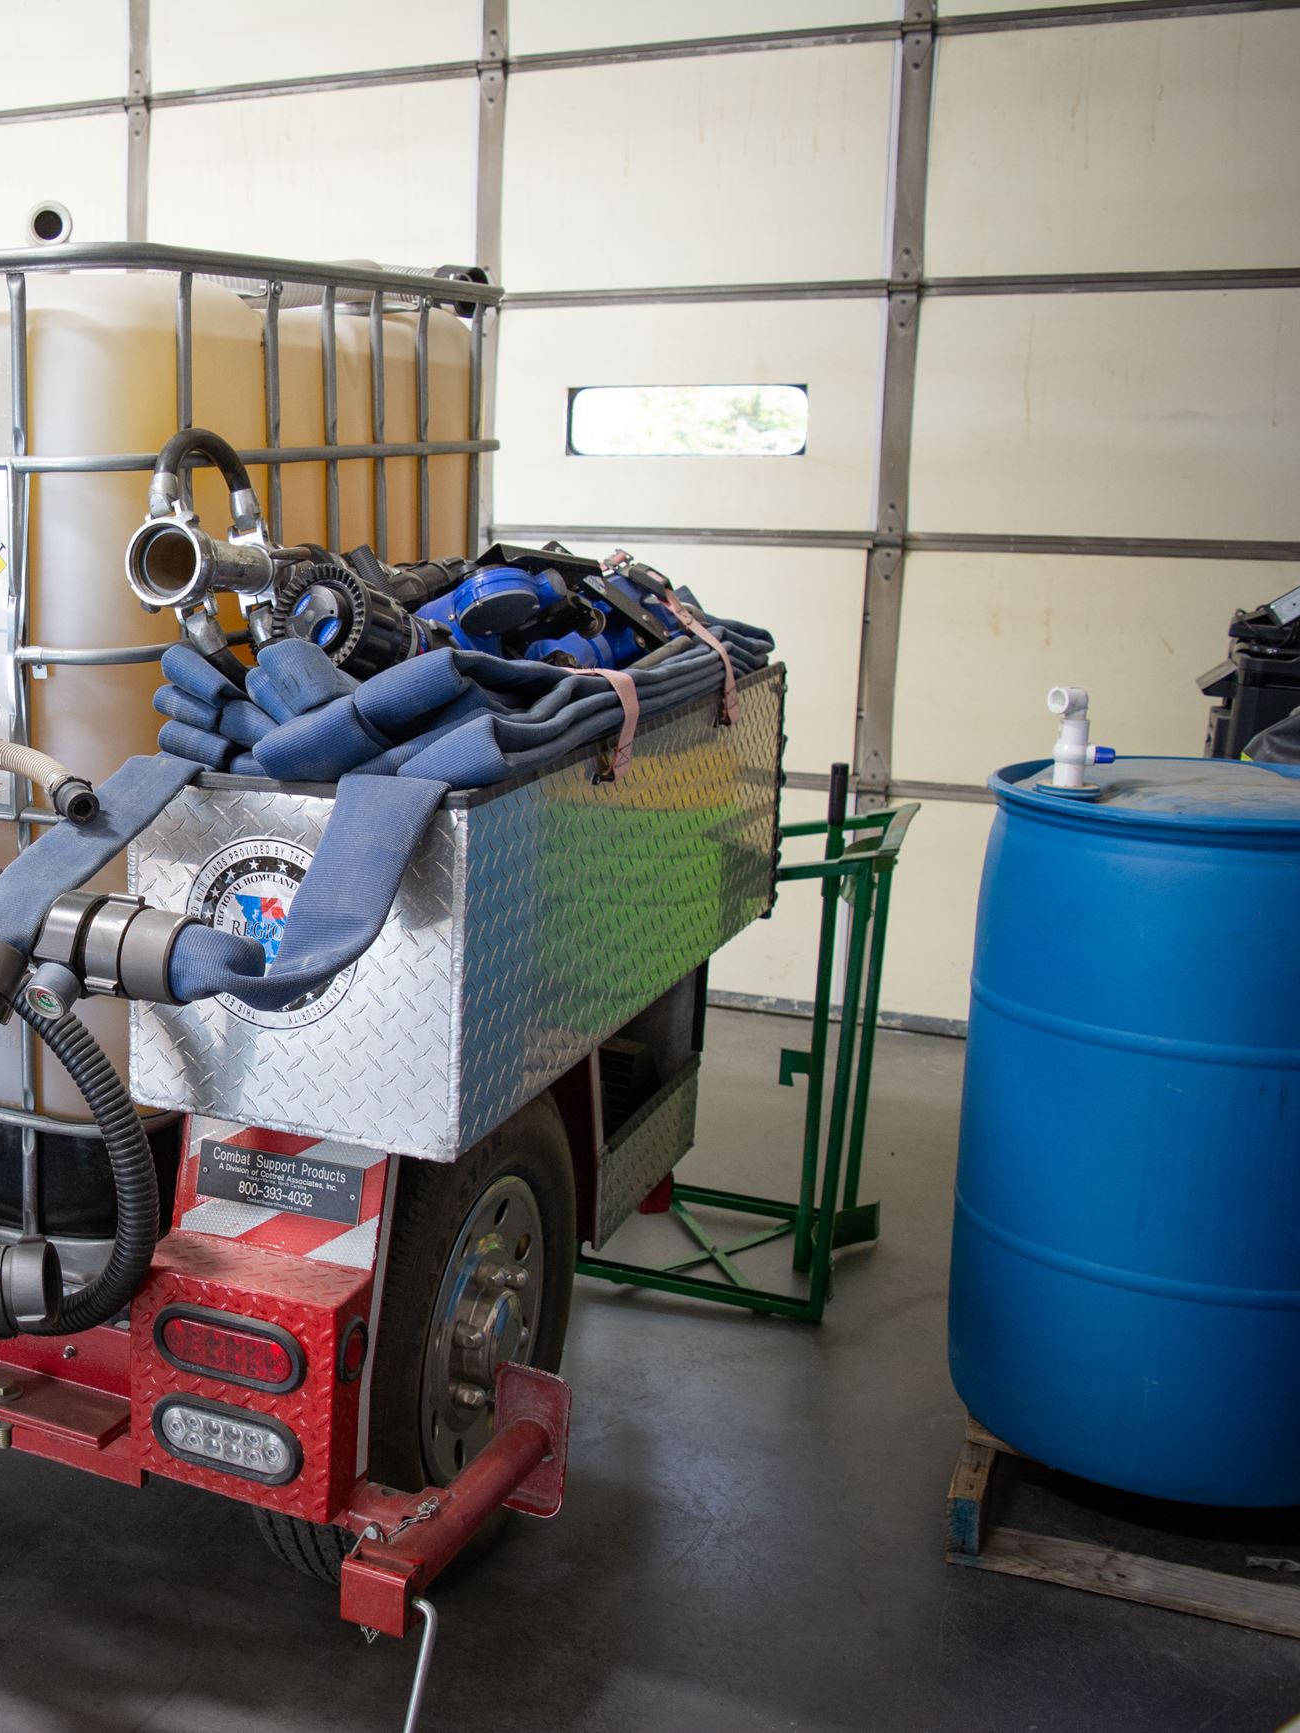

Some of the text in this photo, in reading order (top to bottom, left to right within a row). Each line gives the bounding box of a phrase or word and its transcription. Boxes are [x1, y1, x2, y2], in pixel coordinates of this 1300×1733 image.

[196, 844, 306, 902] WITH FUNDS PROVIDED BY THE
[216, 874, 298, 926] REGIONAL HOMELAND
[232, 920, 284, 940] REGIO
[238, 1004, 256, 1020] THIS
[288, 1001, 326, 1024] SECURITY
[213, 1147, 346, 1184] Combat Support Products
[226, 1164, 250, 1176] Division
[260, 1170, 285, 1182] Cottrell
[286, 1175, 324, 1190] Associates,
[326, 1183, 338, 1192] Inc.
[238, 1180, 313, 1208] 800-393-4032
